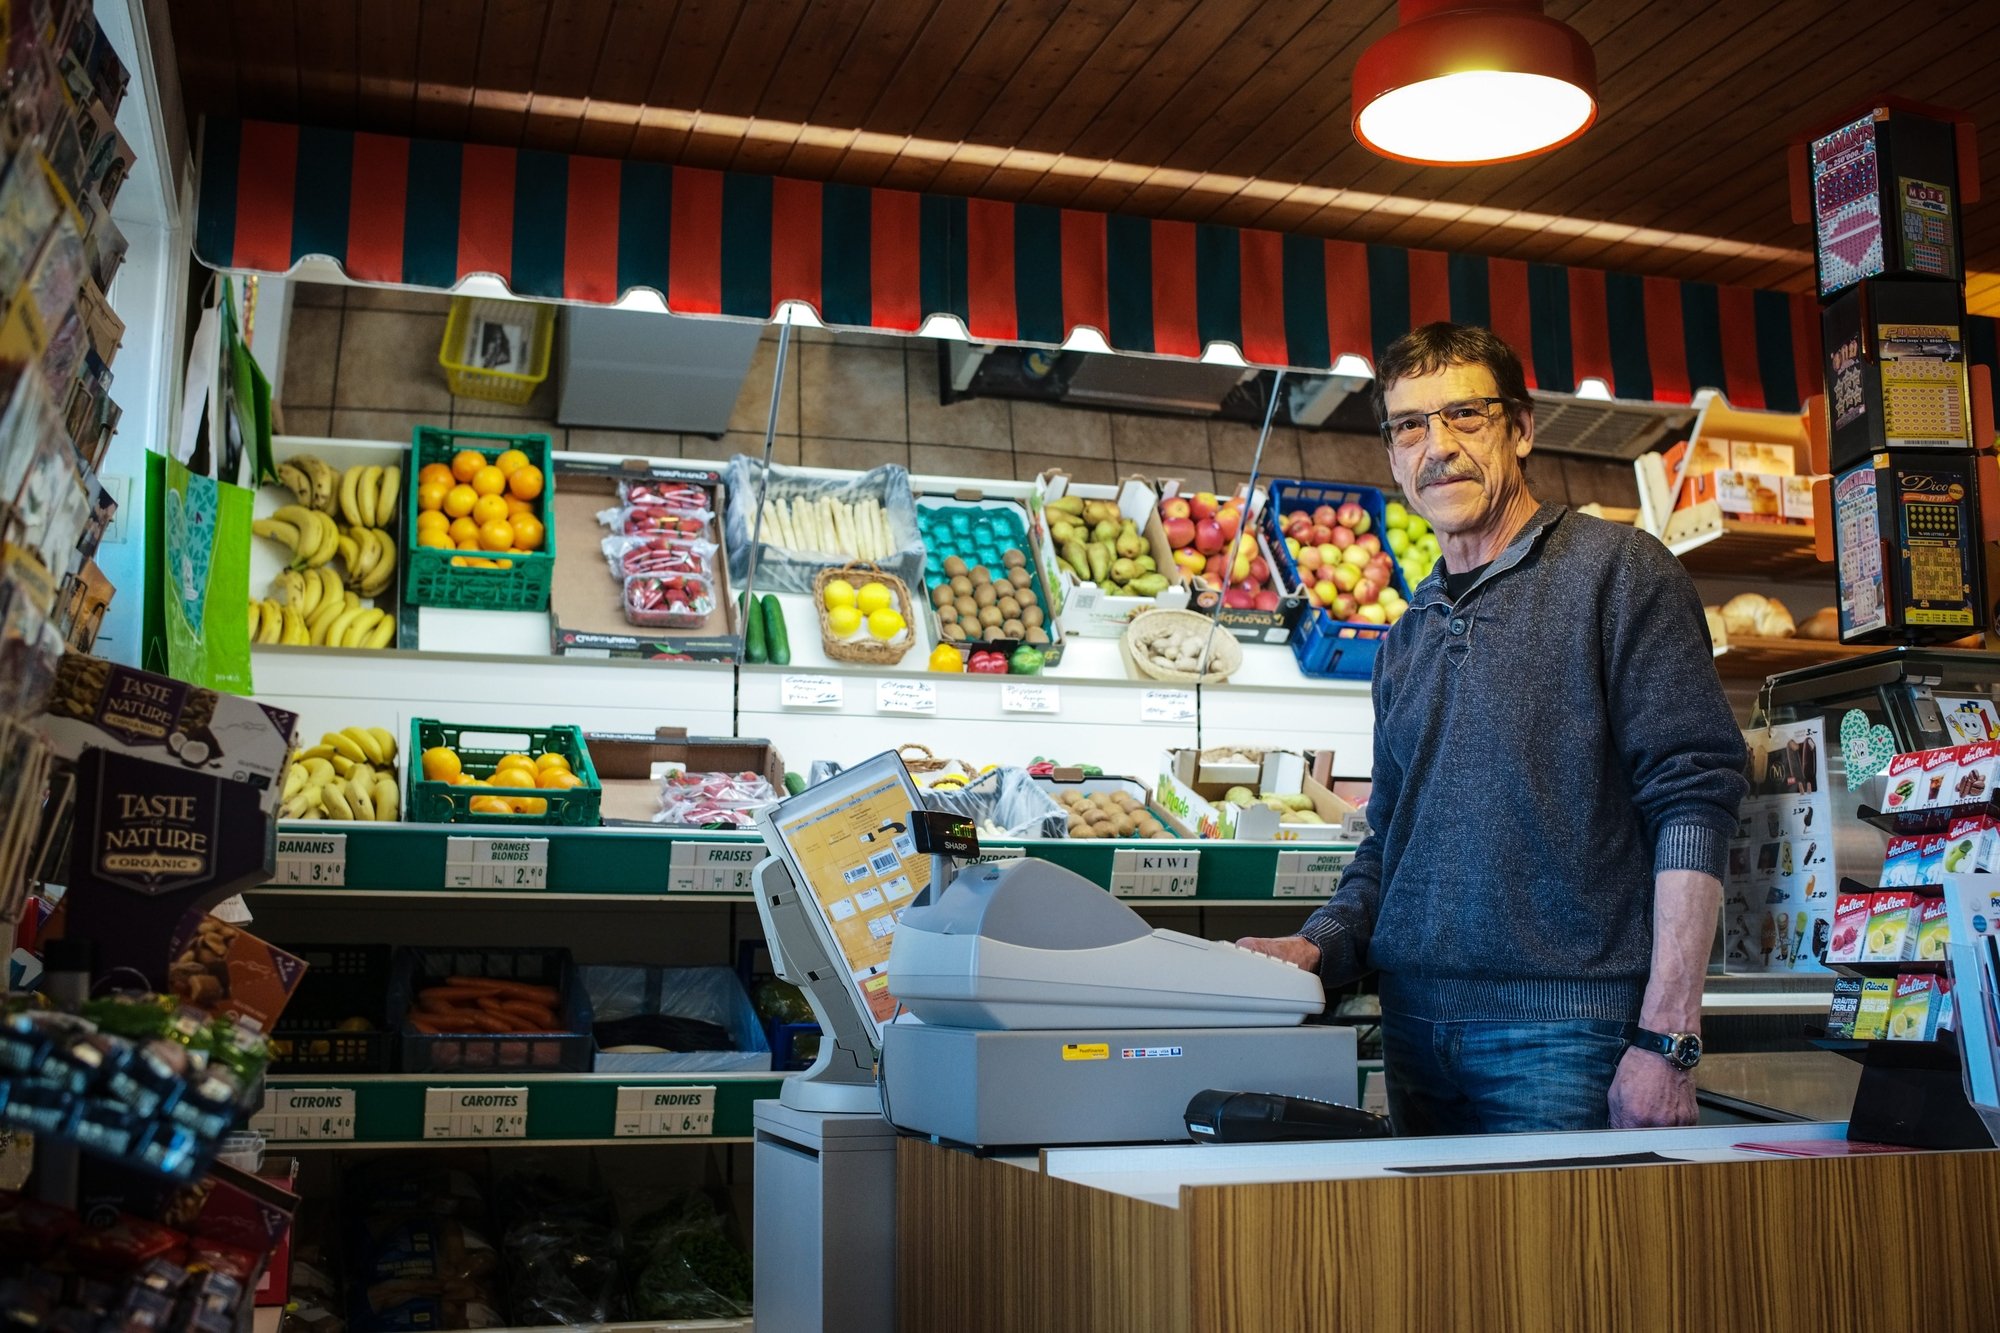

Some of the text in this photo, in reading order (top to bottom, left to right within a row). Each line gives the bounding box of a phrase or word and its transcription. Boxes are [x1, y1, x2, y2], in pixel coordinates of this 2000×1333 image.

[1815, 124, 1875, 163] DIAMANTS
[1908, 187, 1944, 202] MOTS
[1901, 475, 1949, 492] Dico
[121, 676, 173, 705] TASTE
[107, 697, 173, 727] NATURE
[1926, 751, 1954, 769] Halter
[1962, 746, 1992, 764] Halter
[1892, 757, 1920, 775] Halter
[117, 794, 197, 821] TASTE
[1164, 788, 1190, 818] made
[1950, 820, 1979, 838] Halter
[105, 827, 208, 853] NATURE
[278, 840, 335, 853] BANANES
[490, 842, 531, 851] ORANGES
[944, 841, 968, 851] SHARP
[1888, 839, 1918, 857] Halter
[119, 858, 188, 869] ORGANIC
[491, 852, 529, 861] BLONDES
[708, 850, 753, 861] FRAISES
[1143, 857, 1188, 868] KIWI
[1306, 864, 1345, 872] CONFERENC
[1837, 898, 1866, 915] Halter
[1873, 896, 1906, 914] Halter
[1834, 979, 1860, 991] Ricola
[1864, 981, 1889, 991] Ricola
[1897, 978, 1929, 996] Halter
[1833, 996, 1858, 1005] KRÄUTER
[290, 1096, 342, 1108] CITRONS
[461, 1095, 519, 1107] CAROTTES
[654, 1094, 702, 1106] ENDIVES
